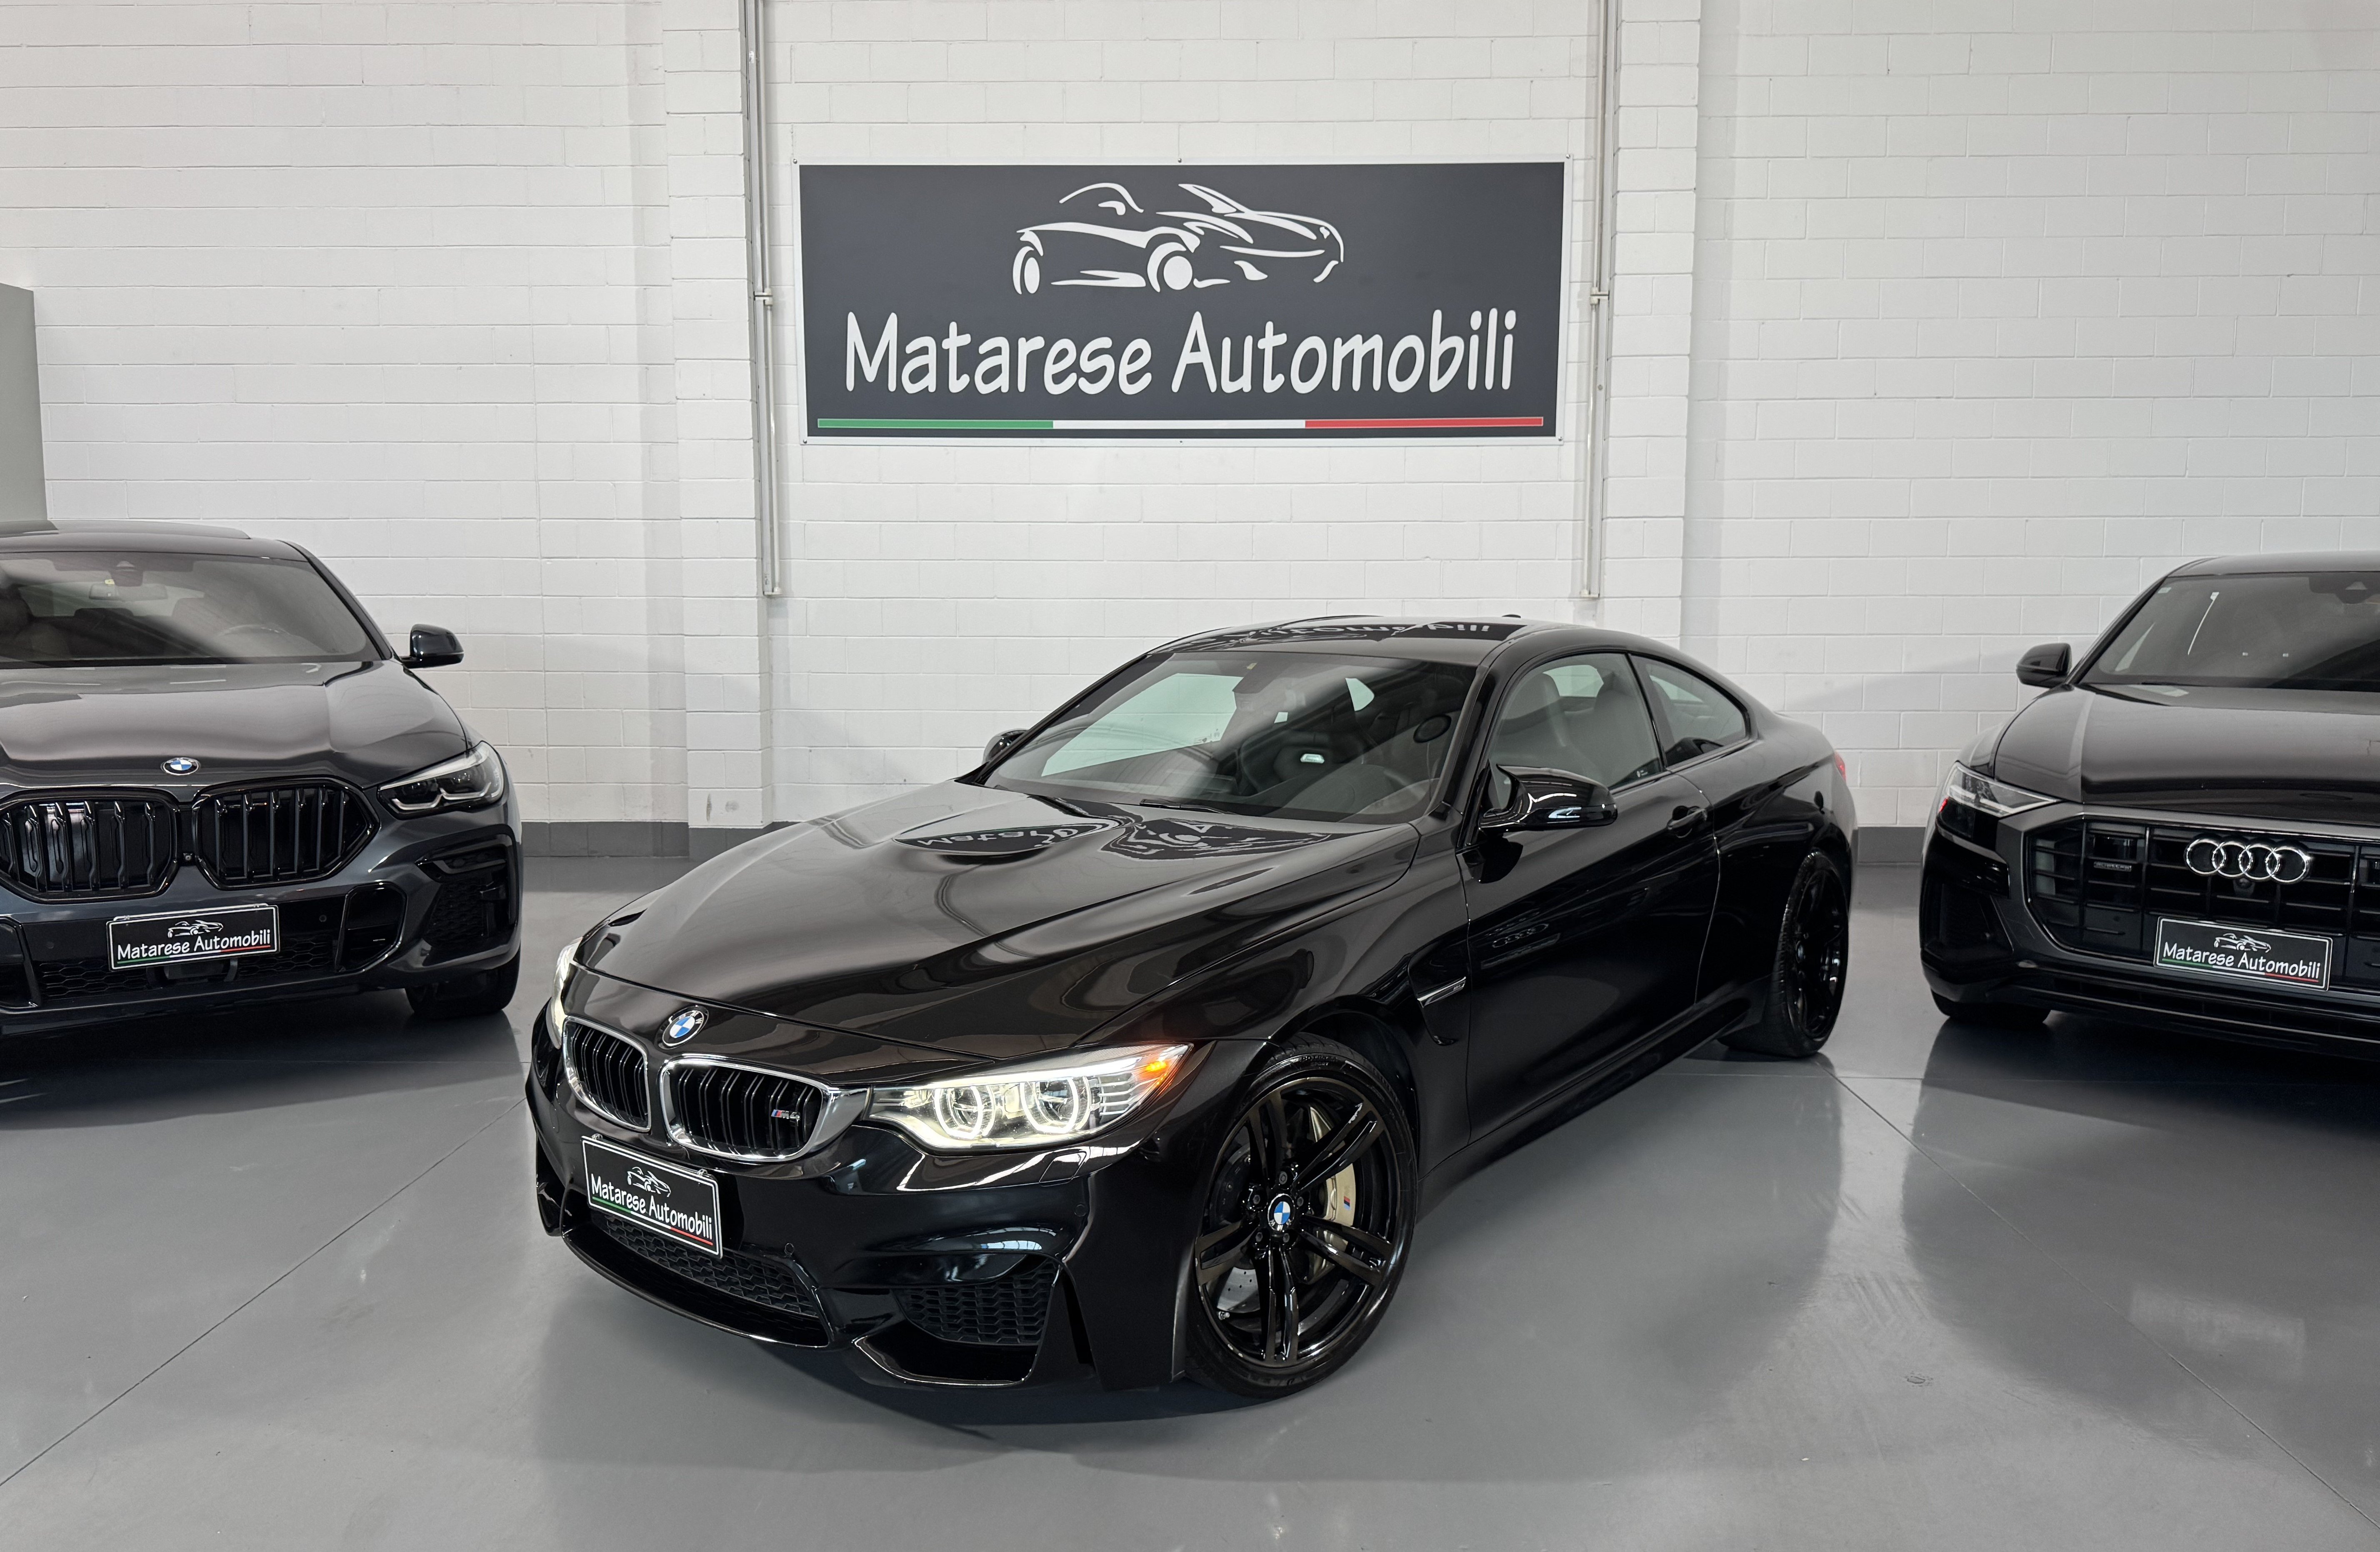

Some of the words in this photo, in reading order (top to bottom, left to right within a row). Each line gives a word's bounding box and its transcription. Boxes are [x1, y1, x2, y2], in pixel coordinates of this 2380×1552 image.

[845, 311, 1152, 396] Matarese
[1171, 307, 1517, 394] Automobili
[117, 941, 190, 960] Matarese
[194, 929, 270, 951] Automobili
[2163, 941, 2234, 967] Matarese
[2238, 952, 2320, 979] Automobili
[591, 1173, 646, 1214] Matarese
[649, 1195, 712, 1240] Automobili
